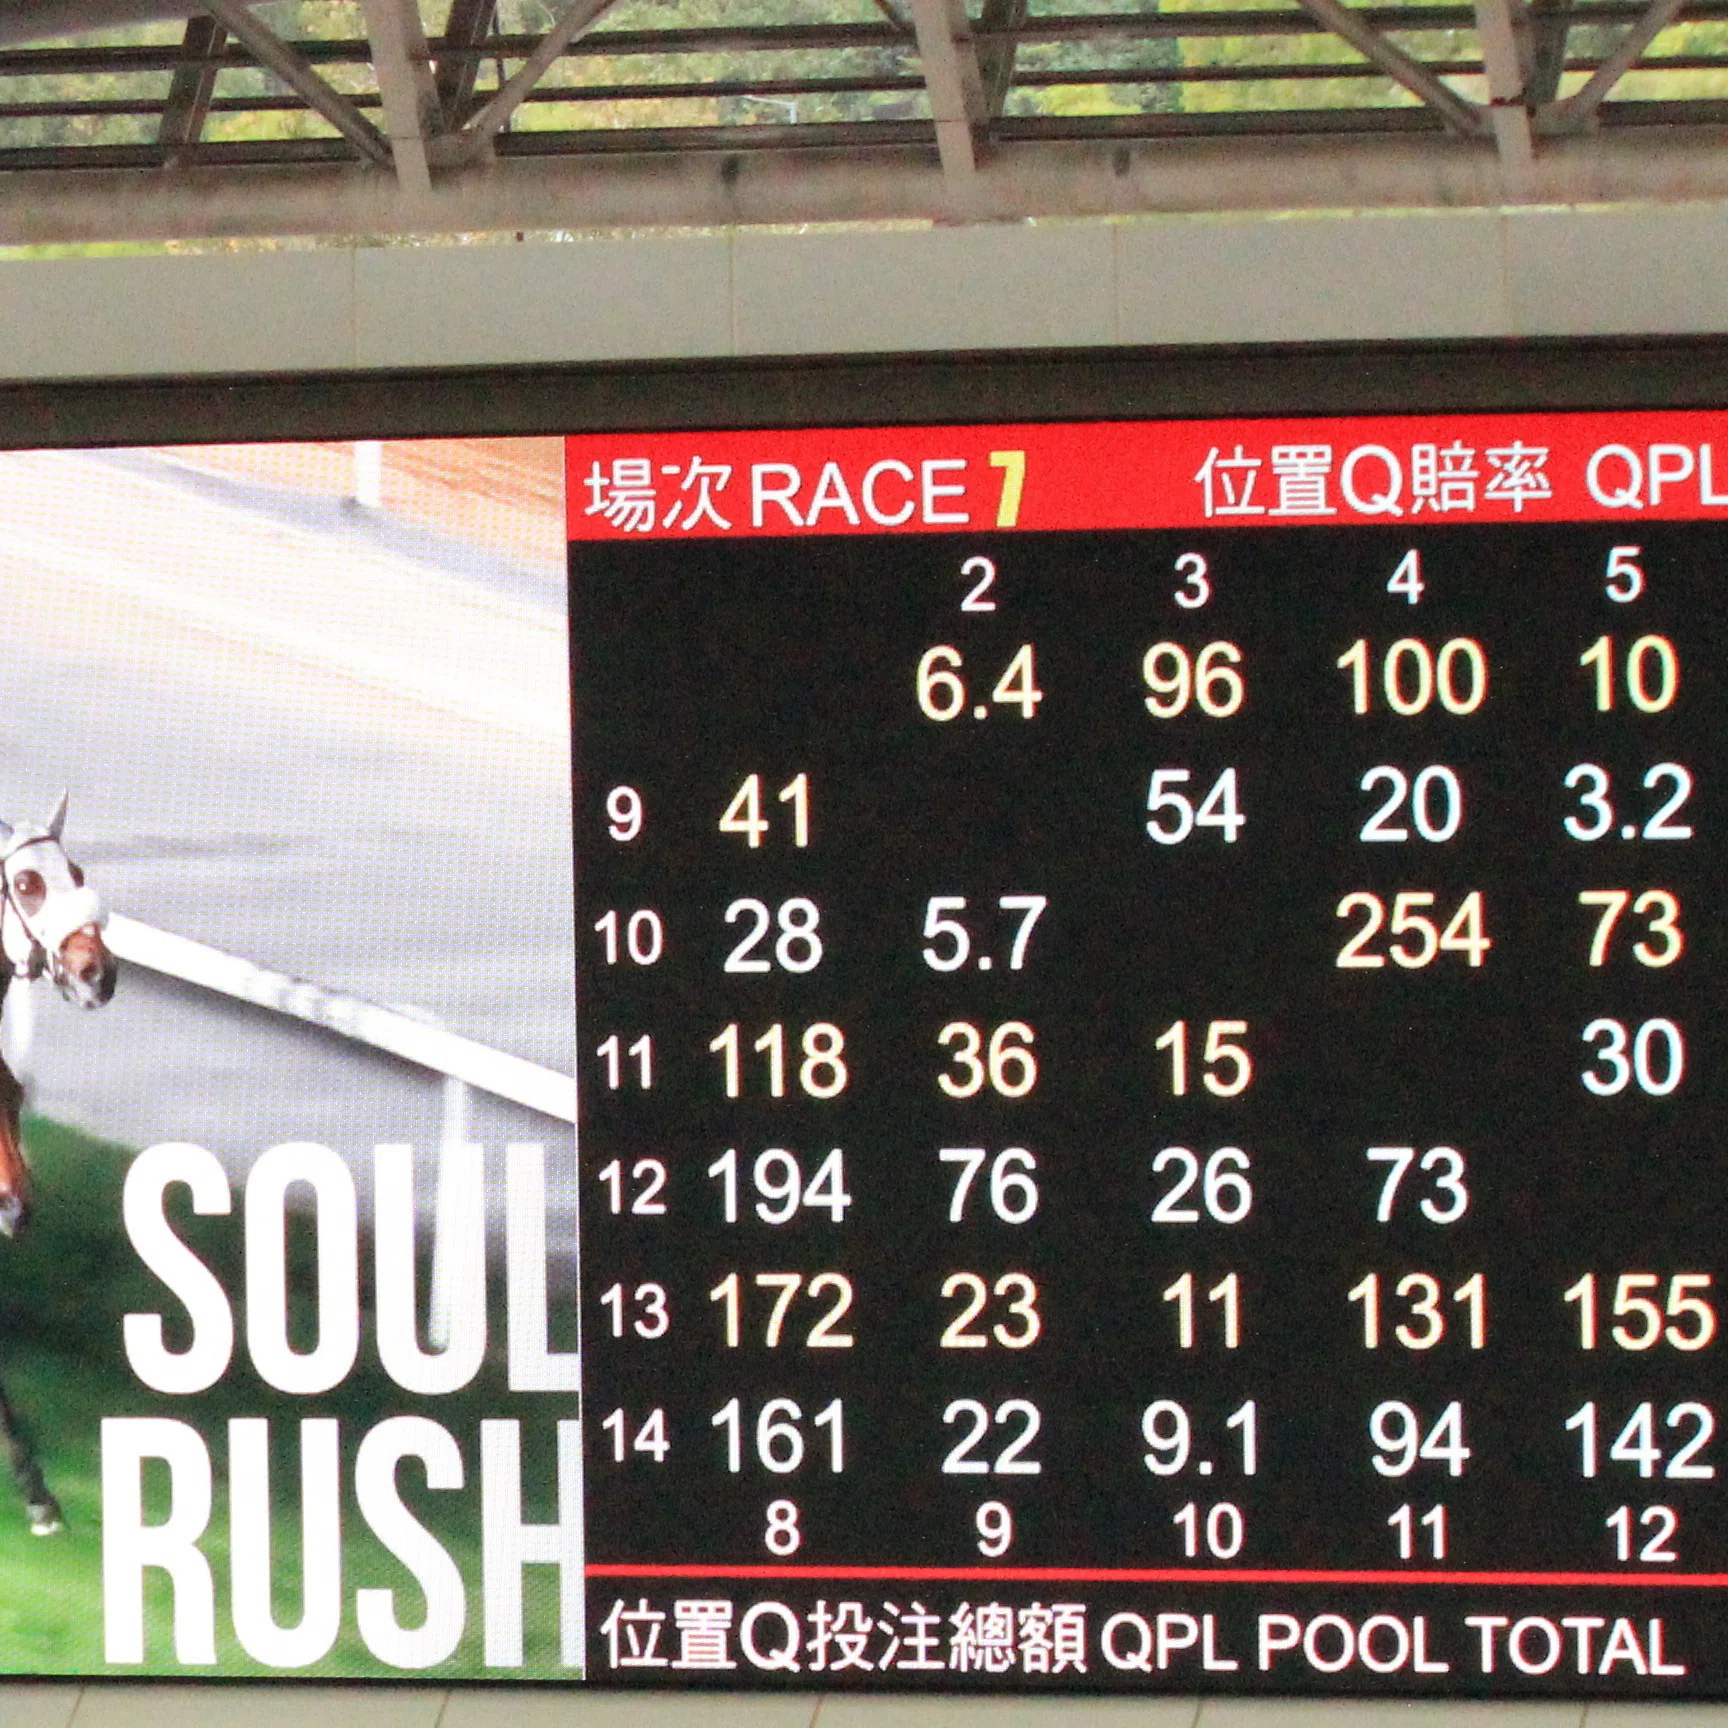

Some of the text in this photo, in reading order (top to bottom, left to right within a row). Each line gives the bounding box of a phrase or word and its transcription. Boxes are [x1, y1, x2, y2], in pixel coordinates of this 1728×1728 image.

[583, 450, 1026, 532] 場次 RACE 7
[1194, 440, 1728, 518] 位置Q賠率 QPL
[960, 547, 1642, 612] 2 3 4 5
[916, 635, 1676, 722] 6.4 96 100 10
[606, 762, 1692, 849] 9 41 54 20 3.2
[594, 890, 1681, 973] 10 28 5.7 254 73
[596, 1018, 1683, 1099] 11 118 36 15 30
[598, 1146, 1468, 1225] 12 194 76 26 73
[123, 1141, 578, 1395] SOUL
[600, 1272, 1714, 1351] 13 172 23 11 131 155
[602, 1397, 1714, 1479] 14 161 22 9.1 94 142
[100, 1415, 583, 1669] RUSH
[764, 1499, 1676, 1562] 8 9 10 11 12
[1101, 1612, 1238, 1673] QPL
[1258, 1614, 1449, 1673] POOL
[1464, 1616, 1685, 1676] TOTAL
